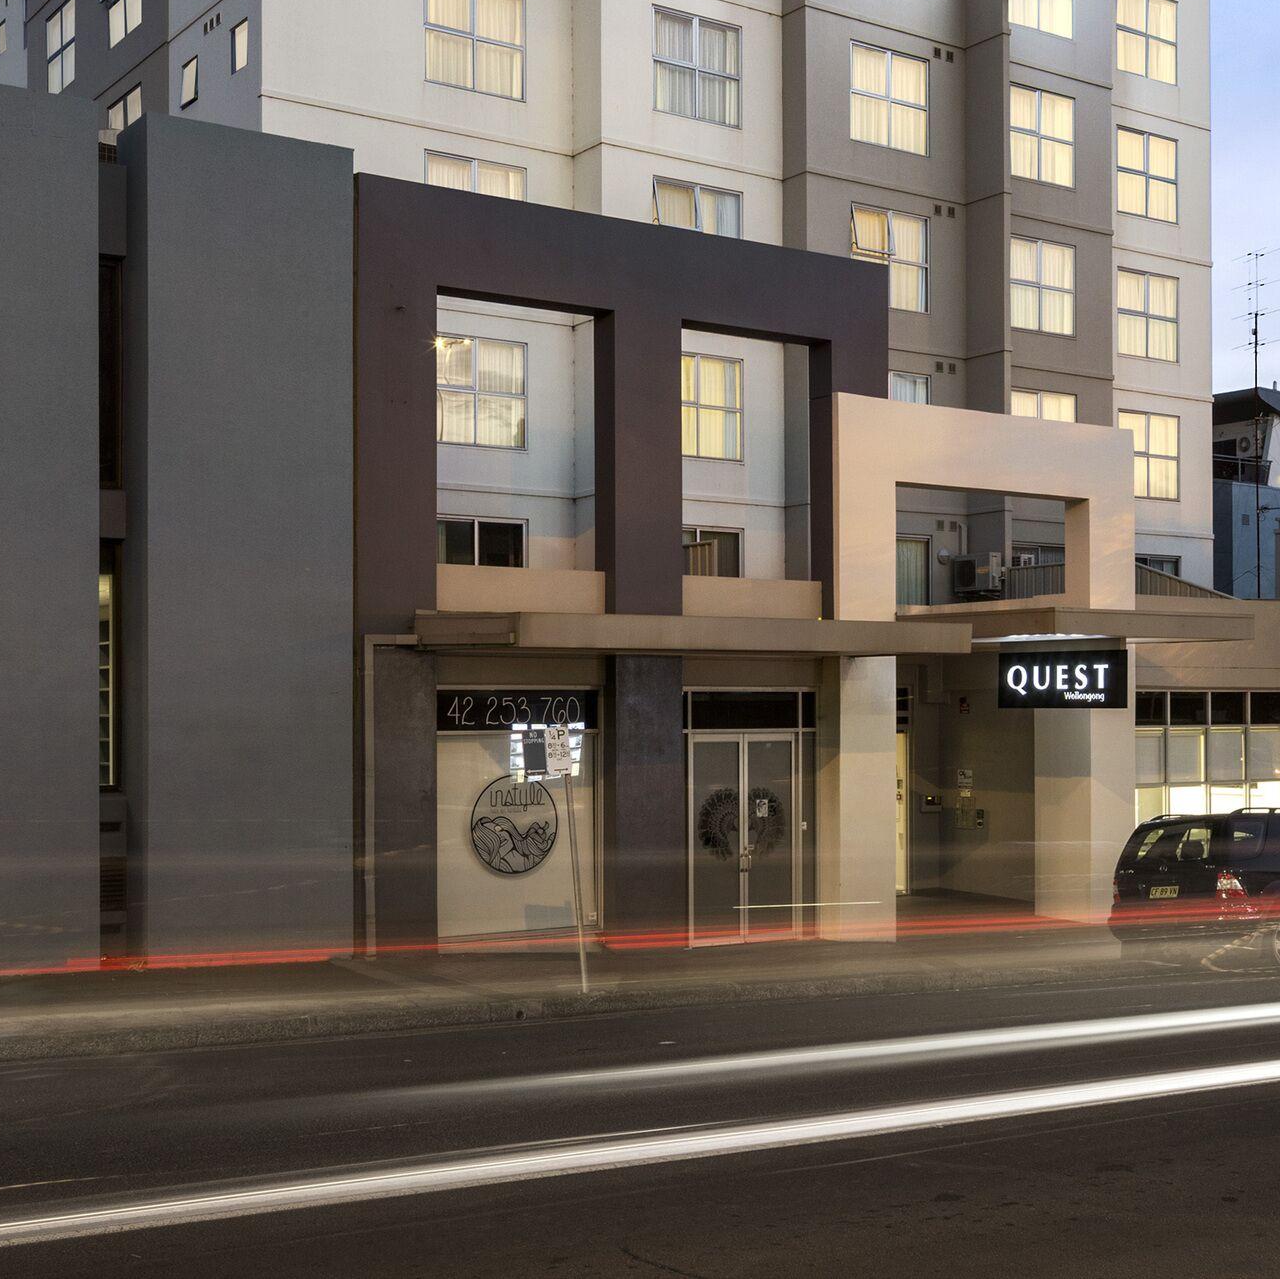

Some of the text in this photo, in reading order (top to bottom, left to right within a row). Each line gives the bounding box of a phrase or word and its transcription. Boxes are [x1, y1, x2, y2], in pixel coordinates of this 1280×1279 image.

[1006, 664, 1109, 696] QUEST
[447, 696, 581, 725] 42 253 760
[1063, 691, 1105, 702] Wollongong
[557, 729, 566, 740] P
[489, 782, 546, 811] instyle
